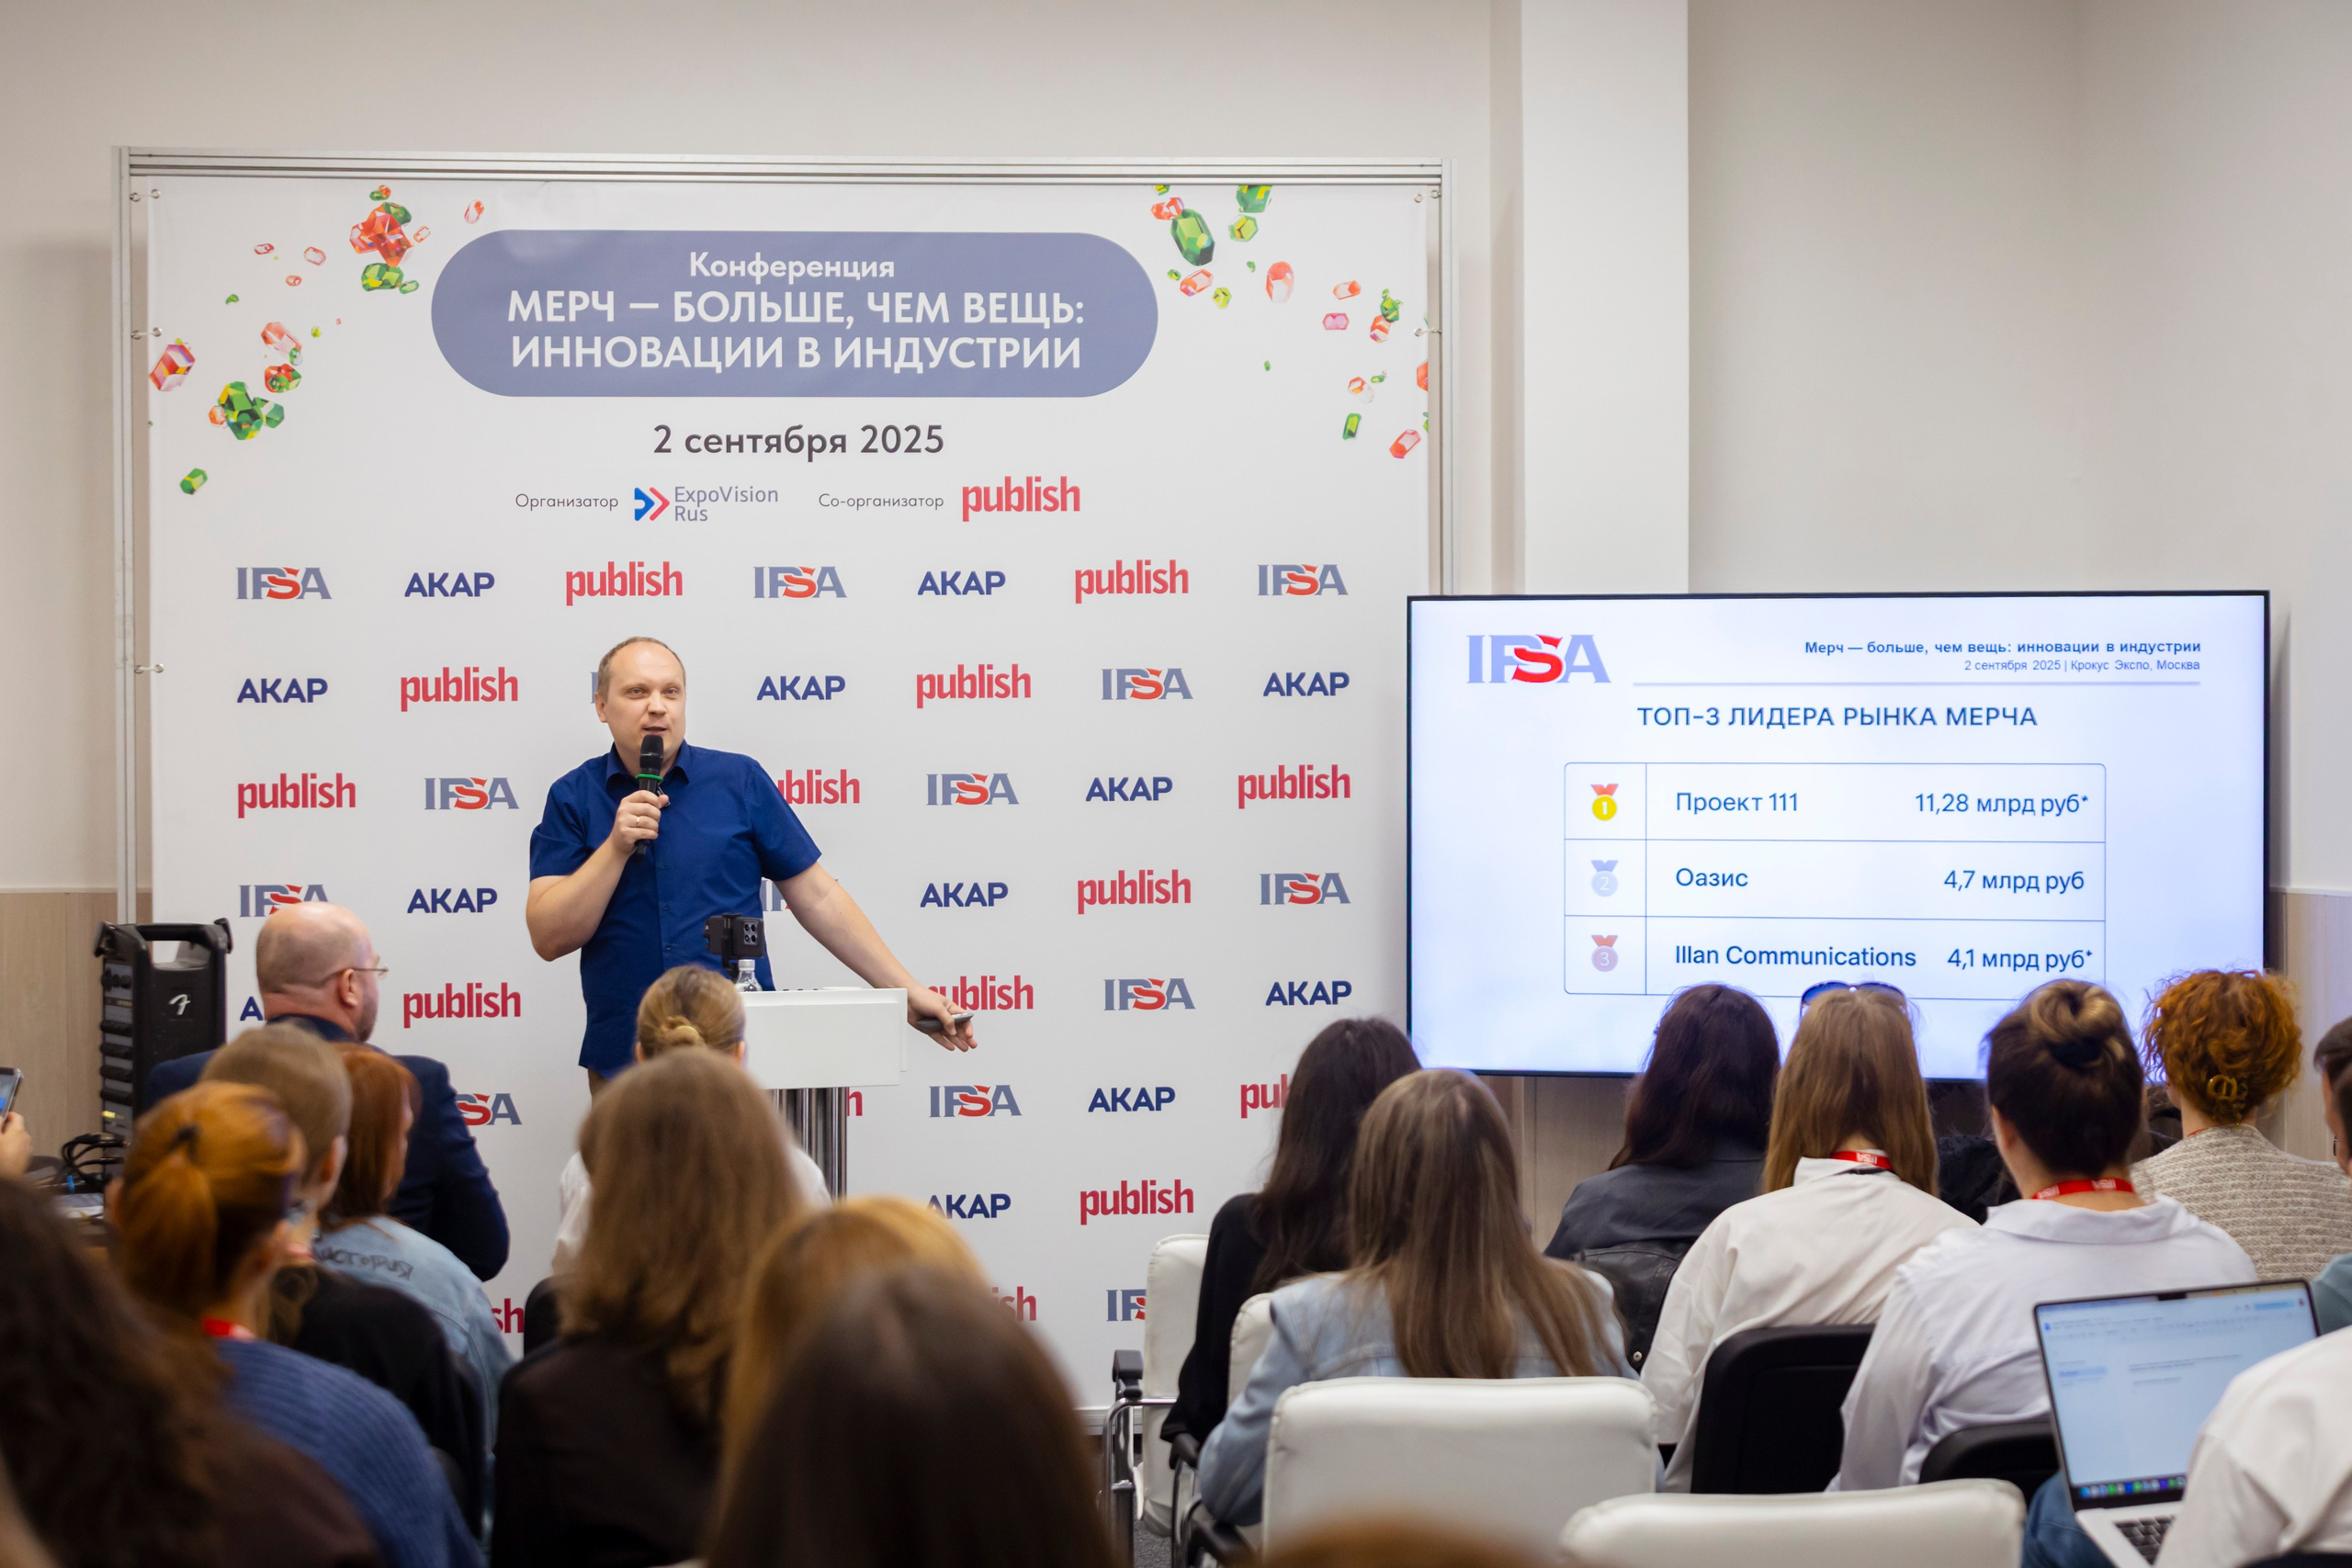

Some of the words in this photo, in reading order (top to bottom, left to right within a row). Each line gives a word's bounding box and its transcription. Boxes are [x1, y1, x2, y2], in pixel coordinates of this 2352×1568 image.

[691, 252, 894, 285] Конференция
[508, 290, 614, 321] МЕРЧ
[674, 291, 854, 329] БОЛЬШЕ,
[867, 292, 949, 322] ЧЕМ
[965, 292, 1083, 329] ВЕЩЬ:
[513, 336, 783, 374] ИННОВАЦИИ
[799, 337, 820, 367] В
[835, 337, 1080, 374] ИНДУСТРИИ
[654, 425, 671, 453] 2
[685, 424, 846, 462] сентября
[861, 425, 944, 453] 2025
[515, 494, 618, 511] Организатор
[675, 486, 779, 507] ExpoVision
[819, 493, 944, 511] Со-организатор
[963, 476, 1080, 522] publish
[675, 506, 708, 522] Rus
[237, 568, 332, 599] IPSA
[566, 561, 683, 606] publish
[754, 567, 846, 598] IPSA
[1076, 559, 1188, 604] publish
[1259, 565, 1348, 595] IPSA
[1467, 634, 1611, 683] IPSA
[1804, 641, 1844, 657] Мерч
[1867, 640, 1928, 655] больше,
[1934, 643, 1962, 653] чем
[1967, 643, 2011, 655] вещь:
[2017, 643, 2099, 654] инновации
[2106, 643, 2115, 652] в
[2120, 642, 2201, 656] индустрии
[1963, 660, 1972, 671] 2
[1974, 660, 2028, 673] сентября
[2032, 659, 2062, 671] 2025
[2070, 660, 2109, 673] Крокус
[2114, 659, 2153, 673] Экспо,
[2156, 660, 2200, 671] Москва
[401, 667, 518, 712] publish
[917, 664, 1031, 708] publish
[1102, 669, 1193, 700] IPSA
[1728, 706, 1836, 729] ЛИДЕРА
[1844, 706, 1938, 727] РЫНКА
[1946, 706, 2038, 727] МЕРЧА
[238, 773, 356, 818] publish
[425, 778, 519, 809] IPSA
[778, 769, 860, 805] blish
[928, 773, 1019, 805] IPSA
[1238, 764, 1351, 809] publish
[1676, 792, 1763, 816] Проект
[1769, 793, 1797, 812] 111
[1915, 793, 1969, 815] 11,28
[1976, 797, 2036, 817] млрд
[1078, 869, 1191, 914] publish
[1261, 873, 1351, 905] IPSA
[1675, 867, 1748, 887] Оазис
[1943, 869, 1976, 892] 4,7
[1982, 874, 2041, 894] млрд
[2045, 870, 2085, 895] руб
[1676, 945, 1719, 964] Illan
[1725, 945, 1917, 967] Communications
[1947, 948, 1974, 970] 4,1
[403, 983, 521, 1028] publish
[928, 976, 1034, 1011] blish
[1104, 978, 1195, 1010] IPSA
[457, 1093, 522, 1125] SA
[930, 1085, 1022, 1117] IPSA
[1080, 1179, 1193, 1225] publish
